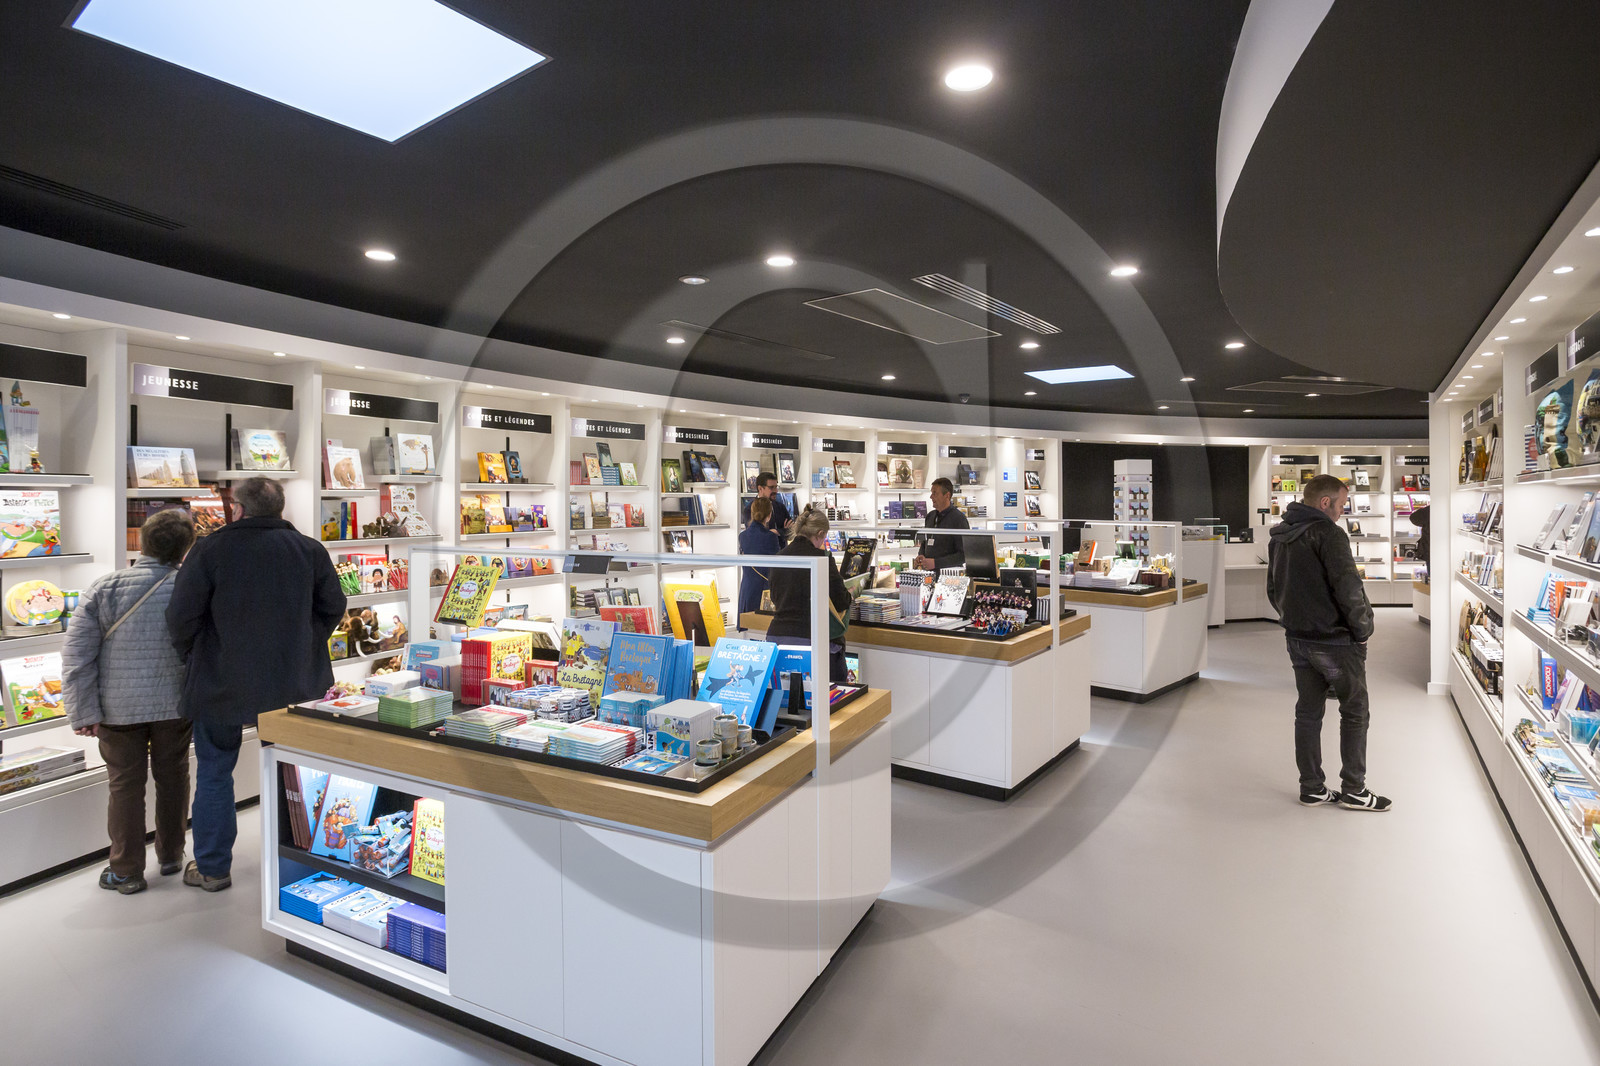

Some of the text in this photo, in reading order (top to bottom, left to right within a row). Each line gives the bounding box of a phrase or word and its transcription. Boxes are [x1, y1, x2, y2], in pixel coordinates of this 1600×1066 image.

[142, 375, 199, 390] JEUNESSE
[331, 397, 370, 408] JEESSE
[467, 413, 492, 422] COTES
[504, 416, 534, 426] LÉGENDES
[606, 426, 631, 434] LÉGENDES
[620, 640, 636, 650] Mon
[620, 652, 652, 667] Bretagne
[718, 651, 760, 661] BRETAGNE
[562, 672, 602, 689] La Bretagne
[1545, 666, 1554, 698] MONOPOLY
